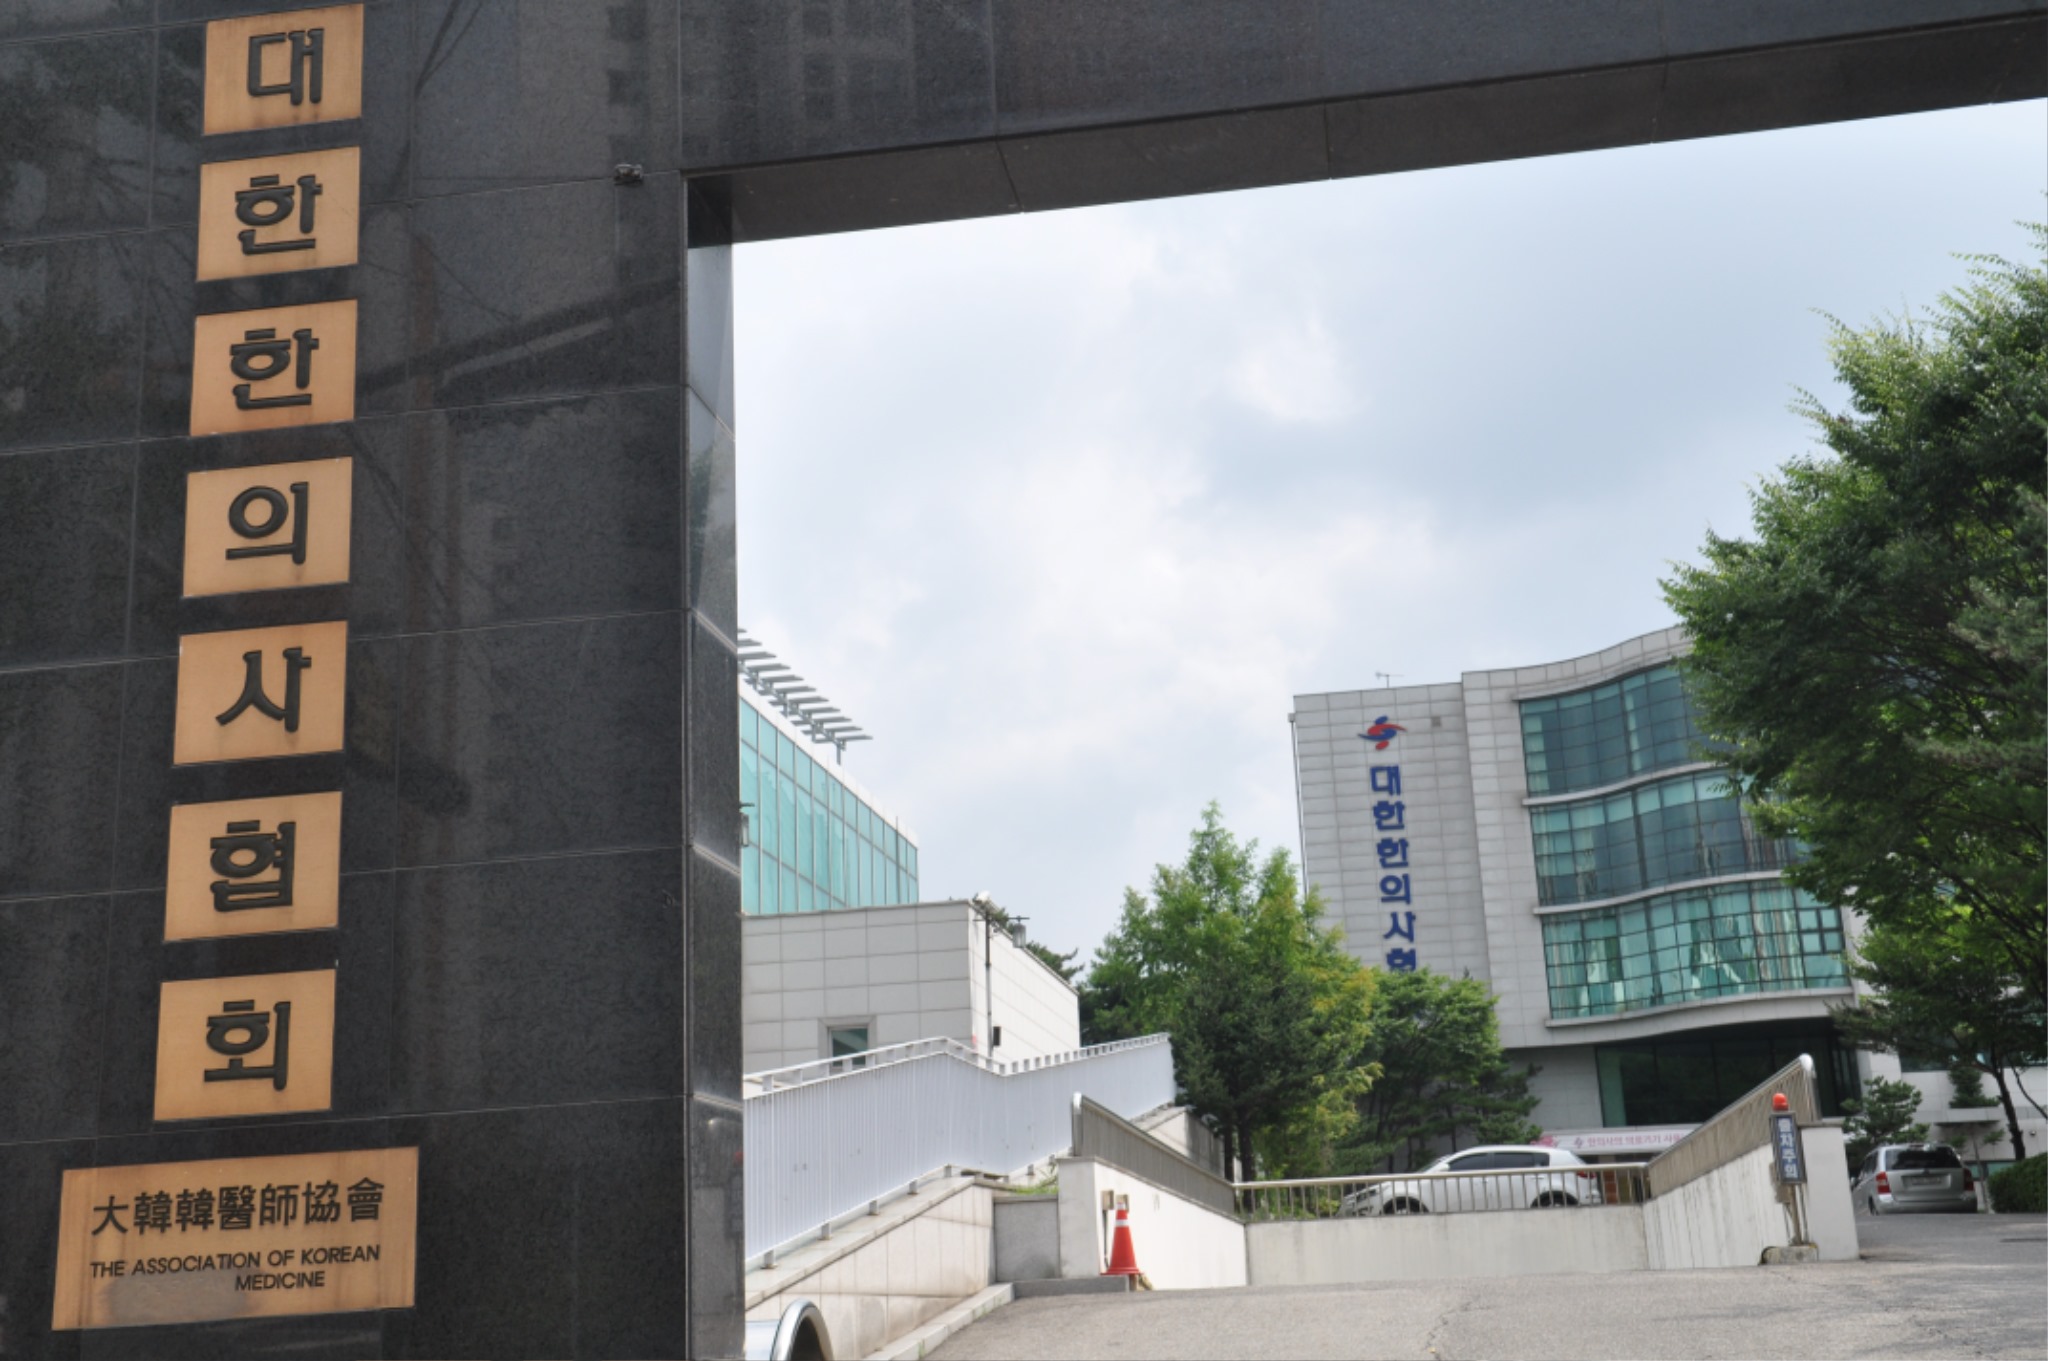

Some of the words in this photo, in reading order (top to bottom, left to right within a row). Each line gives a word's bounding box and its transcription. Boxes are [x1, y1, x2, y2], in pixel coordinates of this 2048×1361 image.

[204, 27, 325, 1091] 대한한의사협회
[91, 1177, 385, 1236] 大韓韓醫師協會
[91, 1260, 126, 1278] THE
[132, 1252, 261, 1276] ASSOCIATION
[268, 1249, 295, 1267] OF
[301, 1244, 381, 1265] KOREAN
[235, 1271, 325, 1291] MEDICINE
